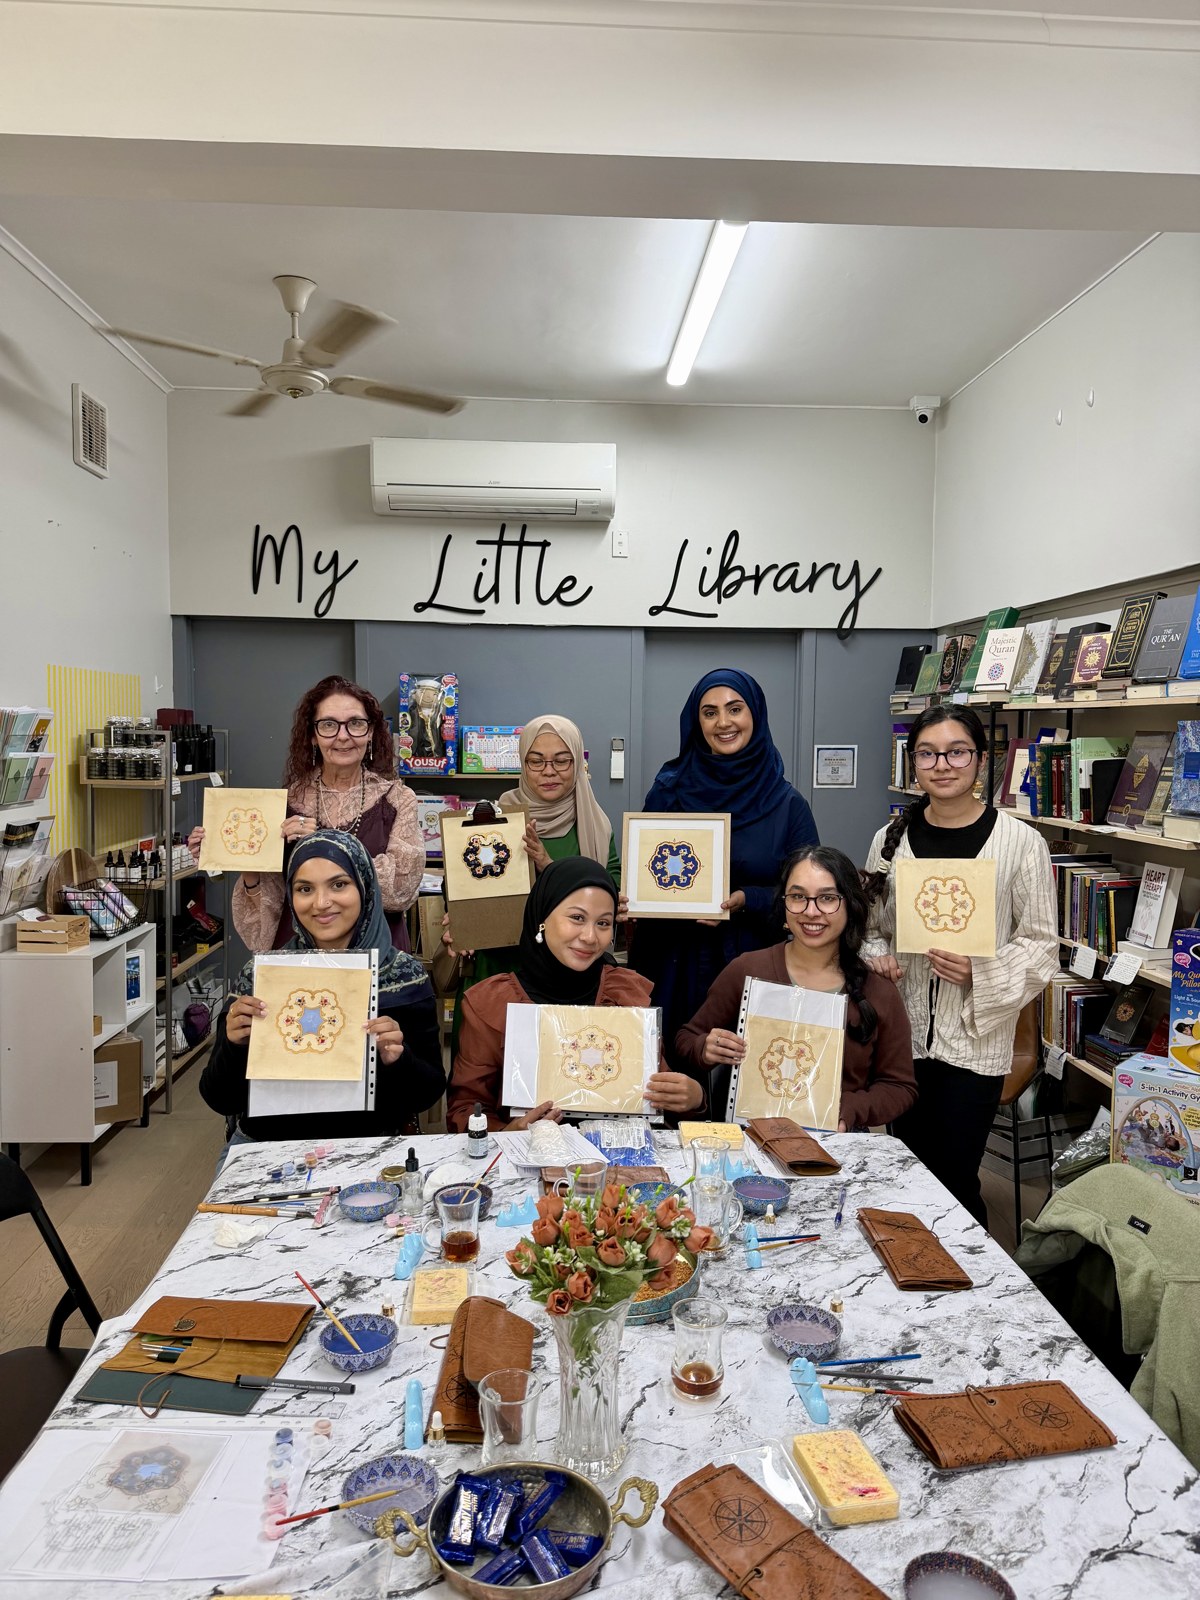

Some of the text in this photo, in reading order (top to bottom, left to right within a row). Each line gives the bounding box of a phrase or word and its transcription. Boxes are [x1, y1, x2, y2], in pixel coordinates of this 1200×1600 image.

[253, 522, 883, 640] My Little Library
[990, 636, 1017, 646] Majestic
[988, 645, 1015, 658] Quran
[1145, 869, 1166, 885] HEART
[1143, 881, 1163, 895] THERAPY
[1172, 970, 1186, 980] My
[1140, 1083, 1161, 1093] 5-in-1
[1162, 1087, 1189, 1099] Activity
